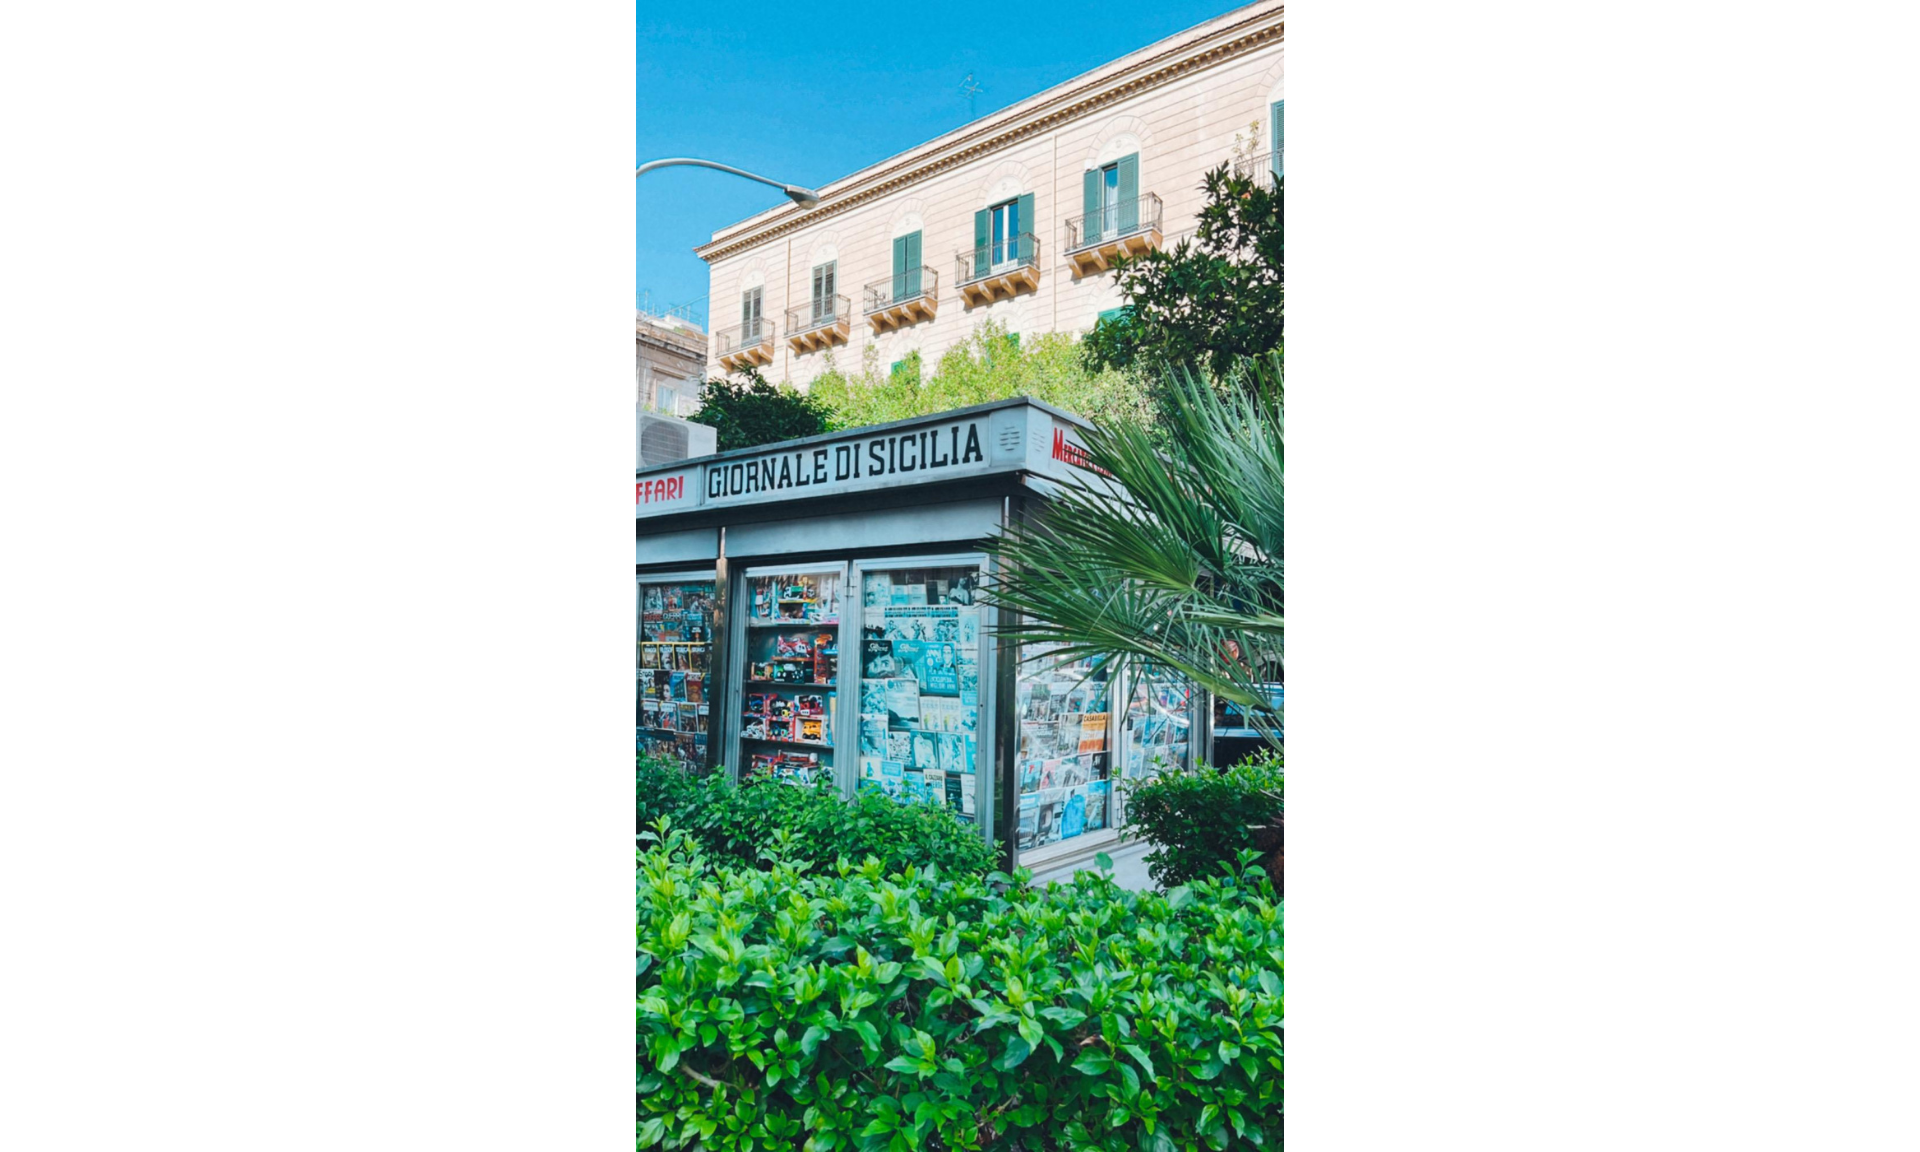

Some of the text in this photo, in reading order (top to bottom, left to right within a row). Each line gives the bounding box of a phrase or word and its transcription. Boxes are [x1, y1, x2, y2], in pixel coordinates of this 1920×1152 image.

[707, 423, 984, 499] GIORNALE DI SICILIA
[1051, 427, 1090, 469] MERCAT
